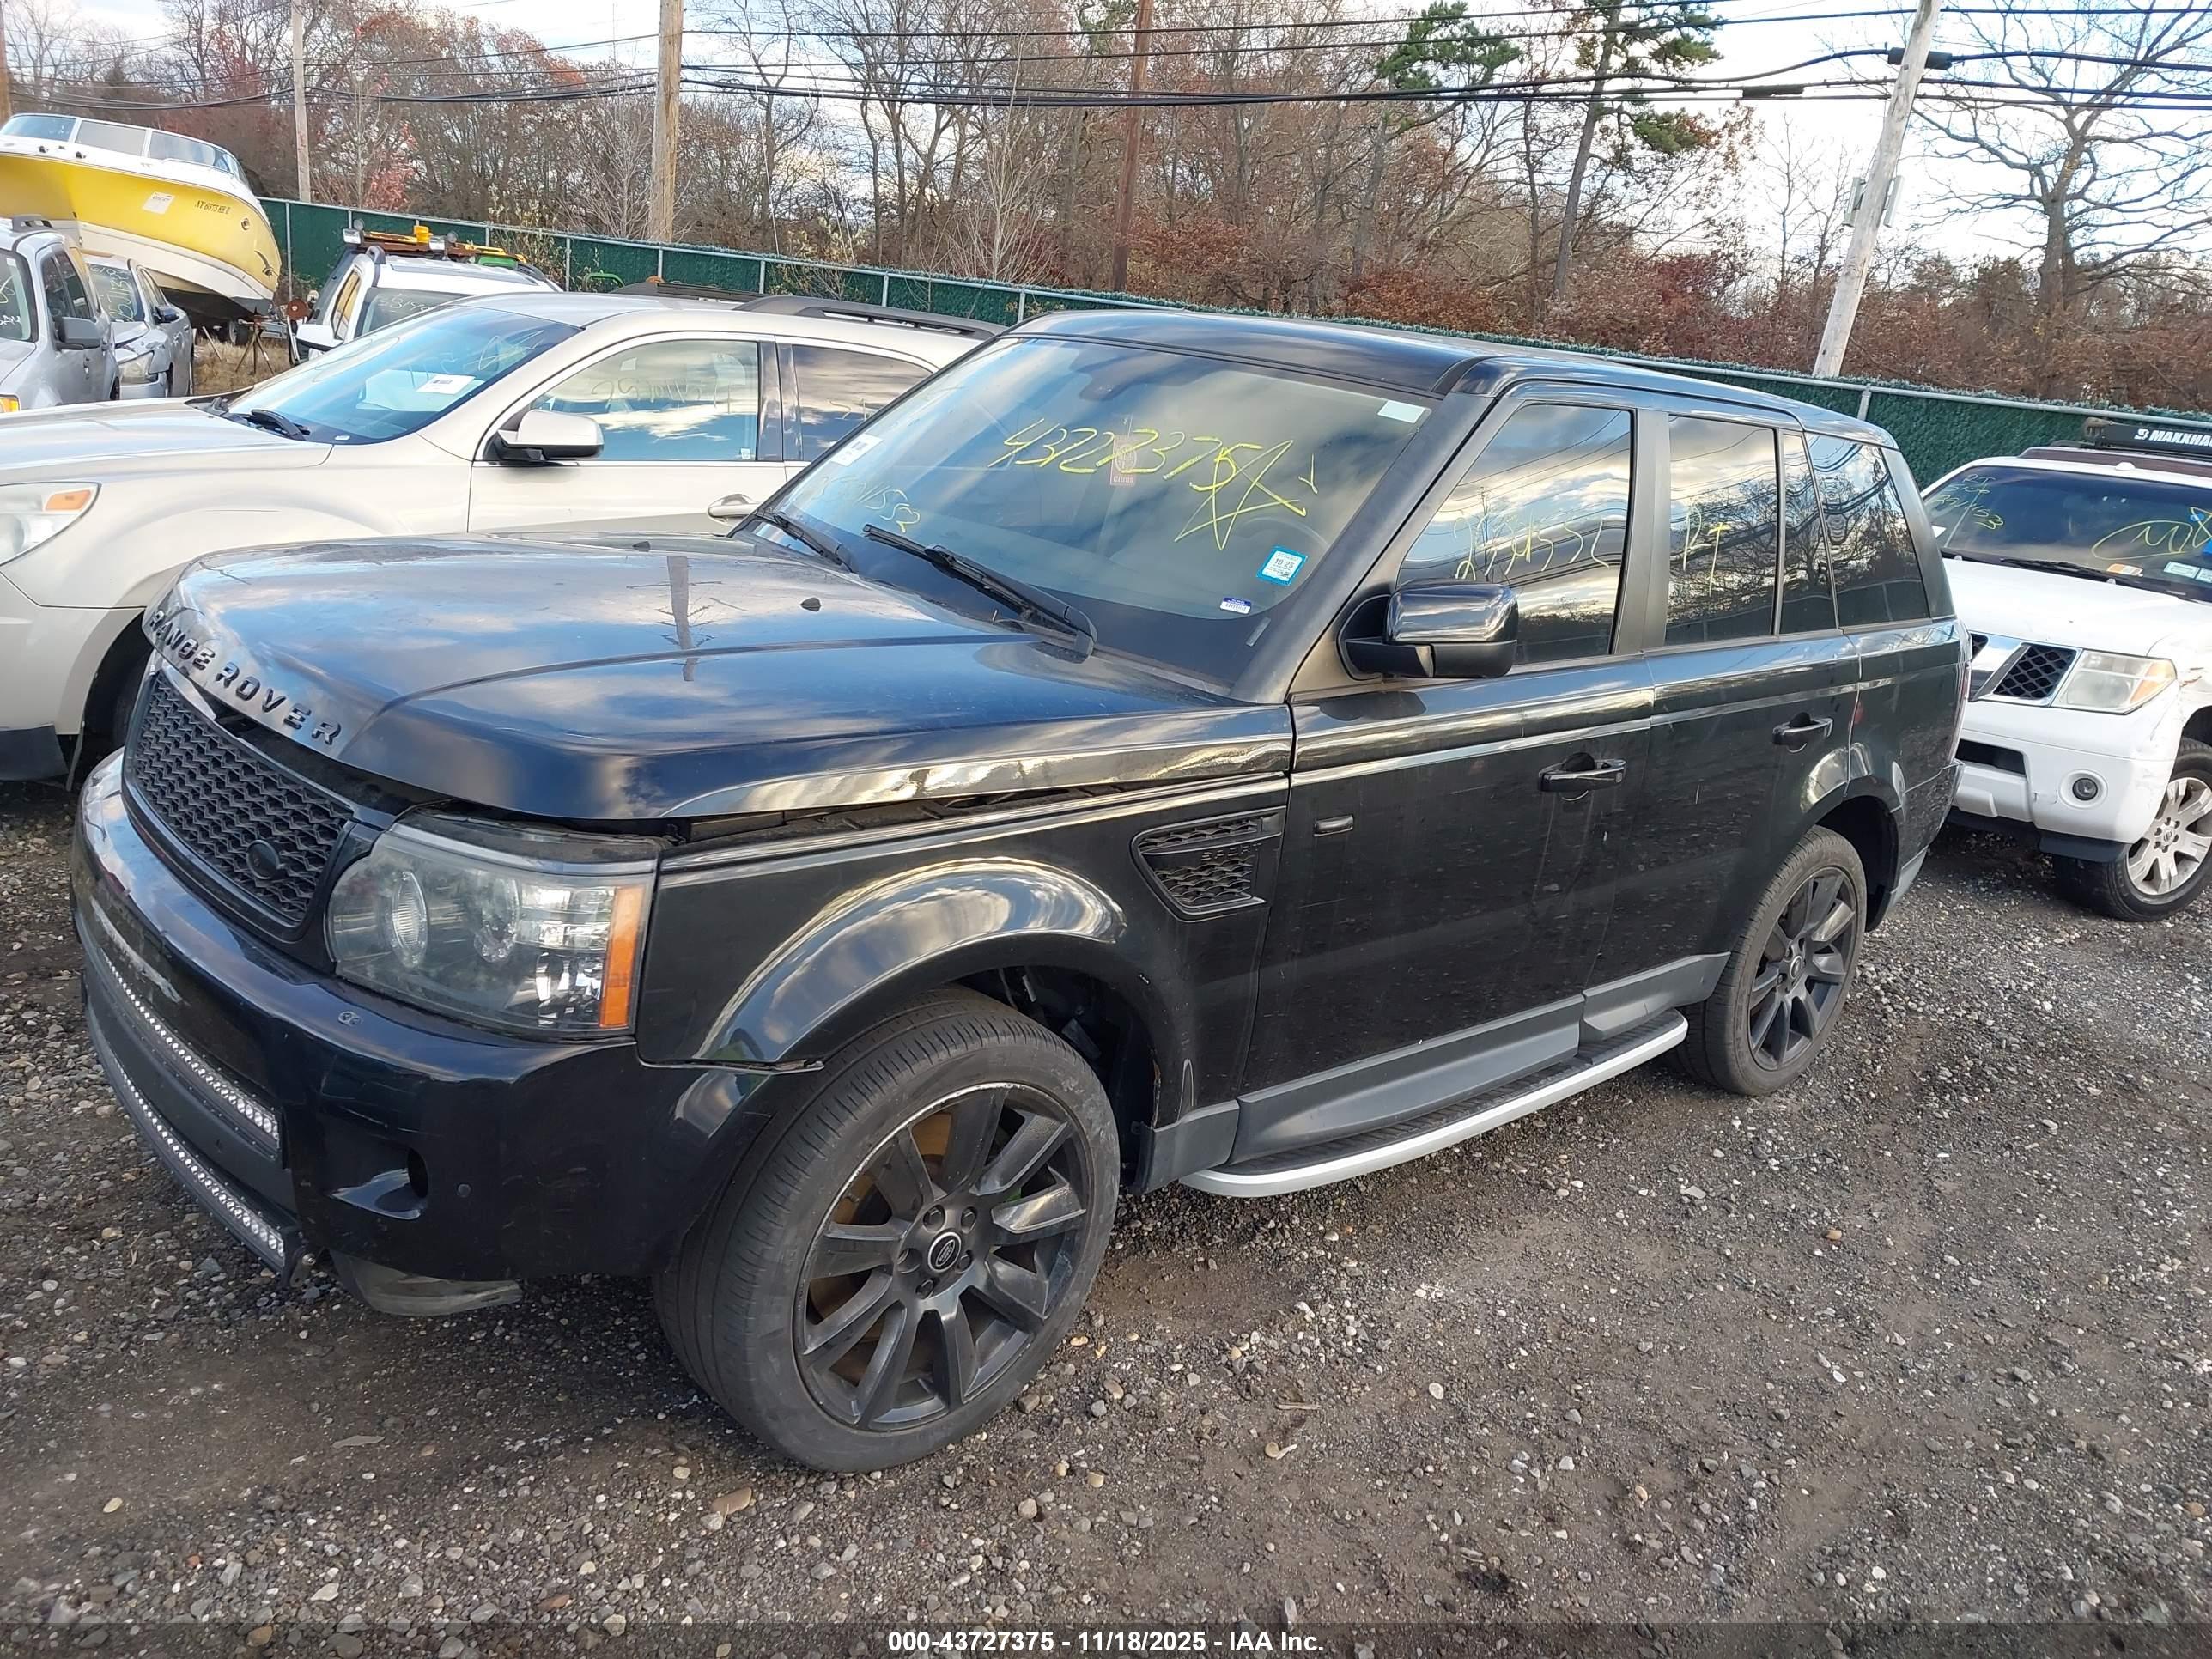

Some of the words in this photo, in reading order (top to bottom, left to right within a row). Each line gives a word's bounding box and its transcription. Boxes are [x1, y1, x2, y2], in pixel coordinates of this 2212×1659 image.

[2148, 430, 2212, 447] MAXXHA
[149, 610, 216, 671] RANGE
[215, 662, 342, 745] ROVER
